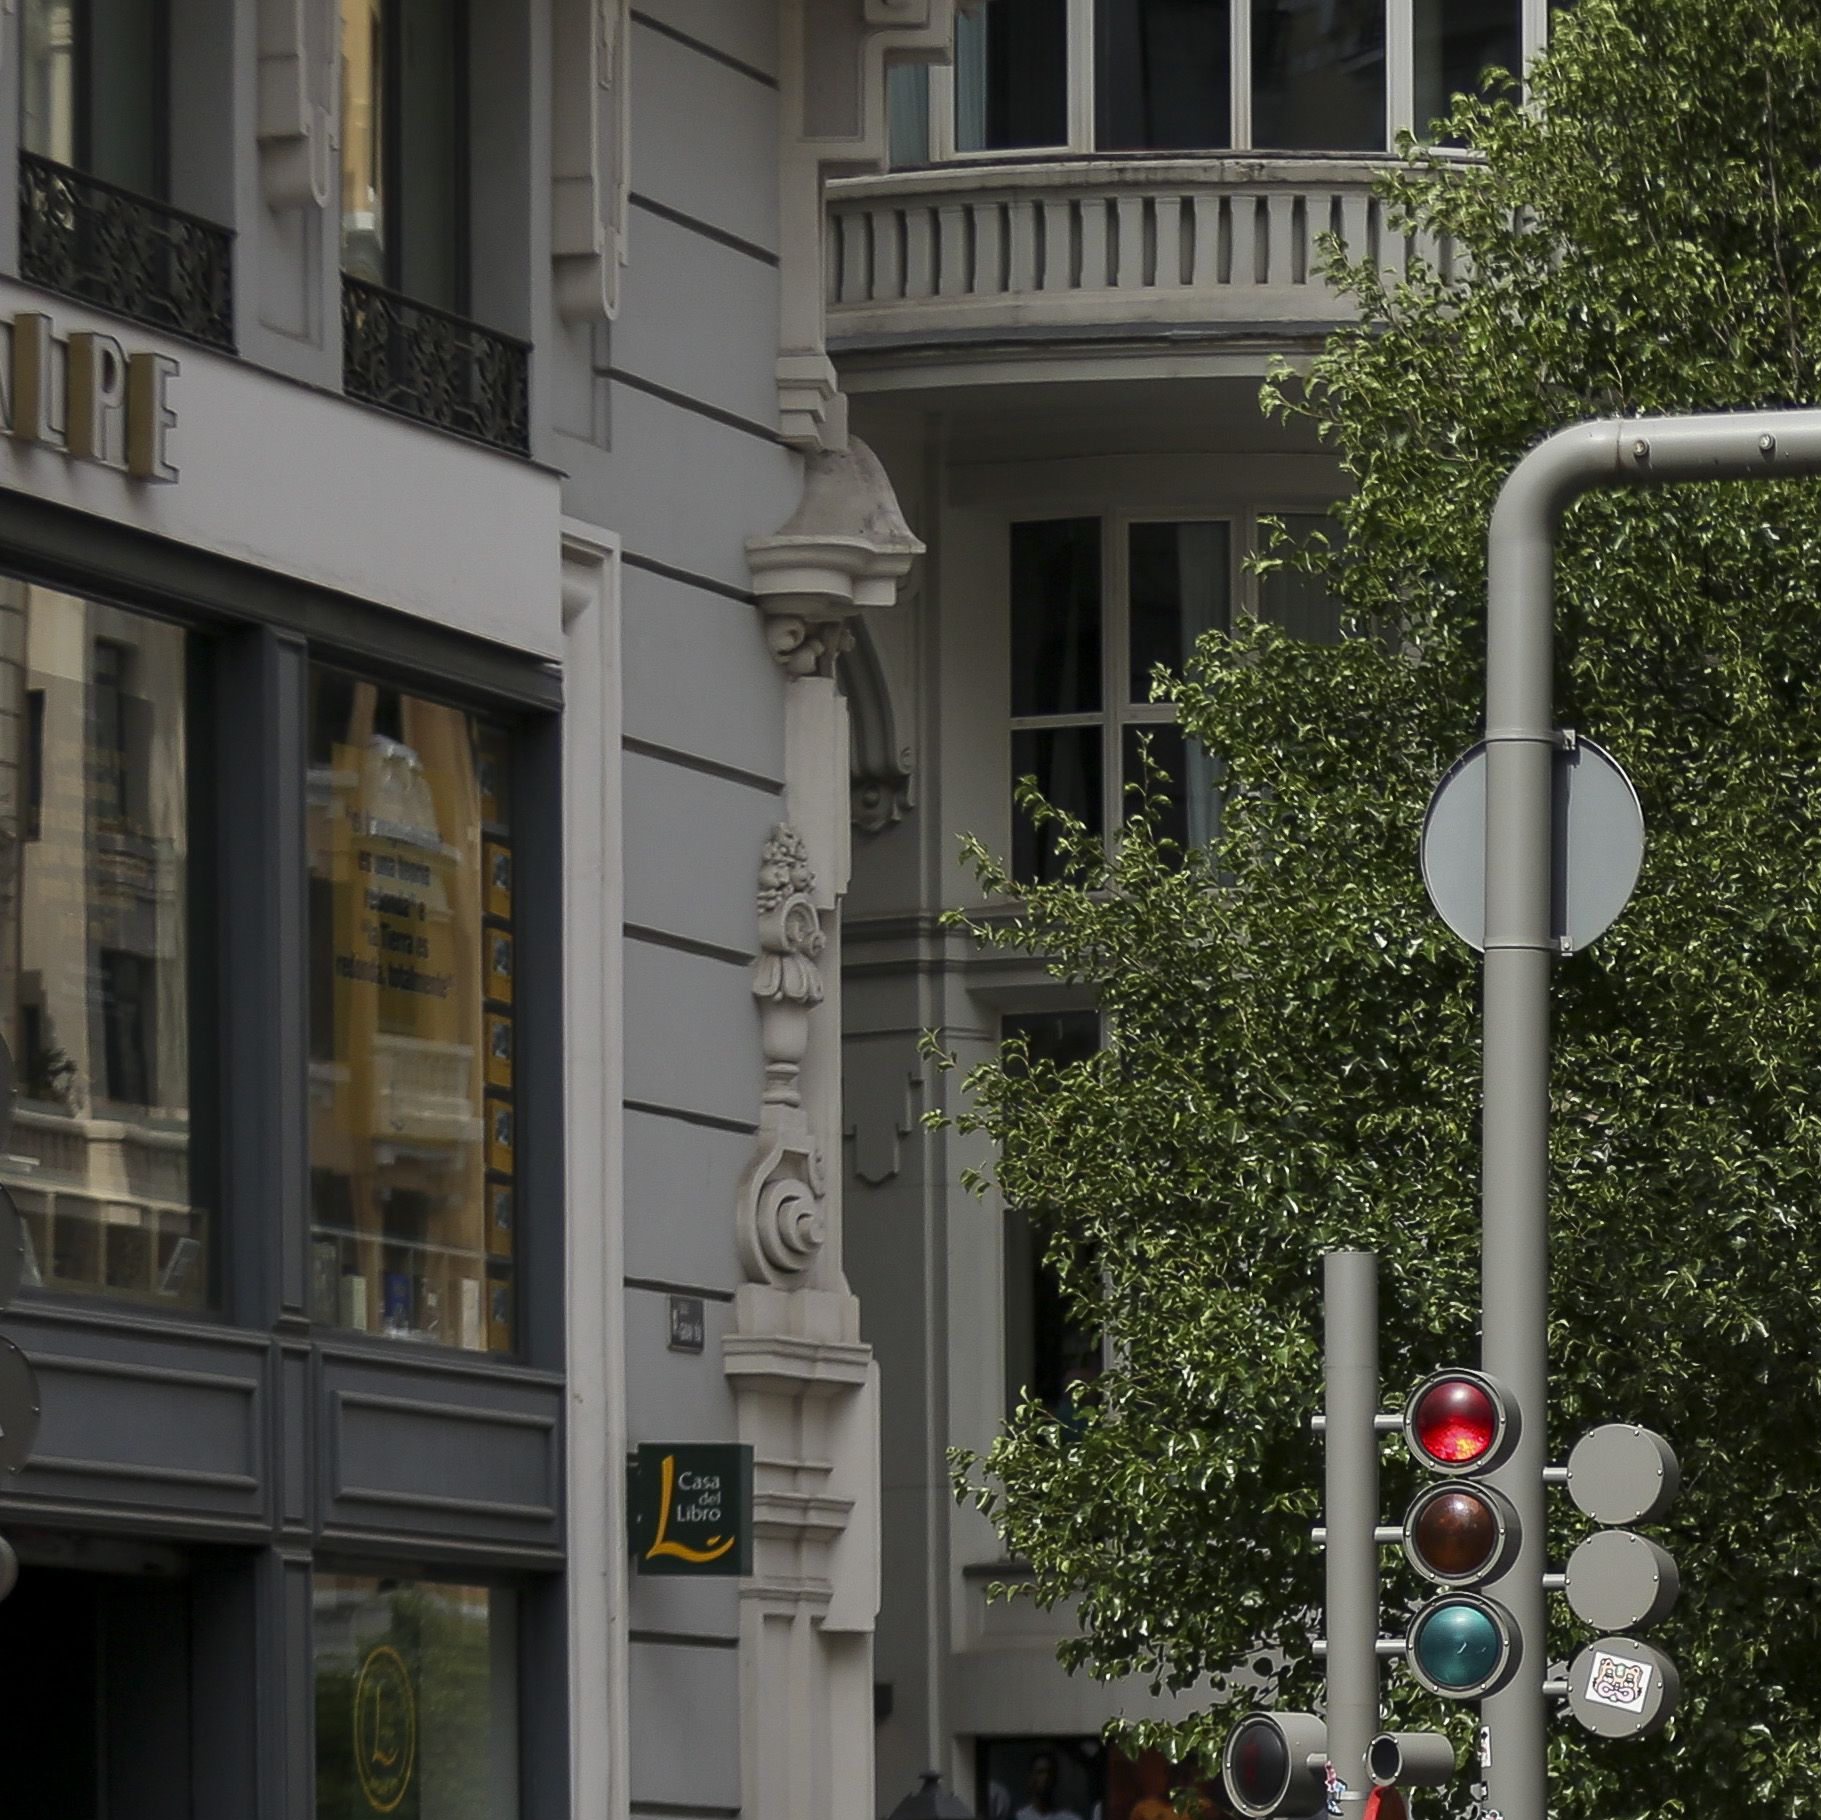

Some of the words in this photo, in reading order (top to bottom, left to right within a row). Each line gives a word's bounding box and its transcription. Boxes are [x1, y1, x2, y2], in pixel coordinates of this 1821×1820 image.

[0, 311, 181, 486] LPE
[678, 1471, 721, 1491] Casa
[698, 1491, 722, 1506] del
[676, 1505, 722, 1522] Libro
